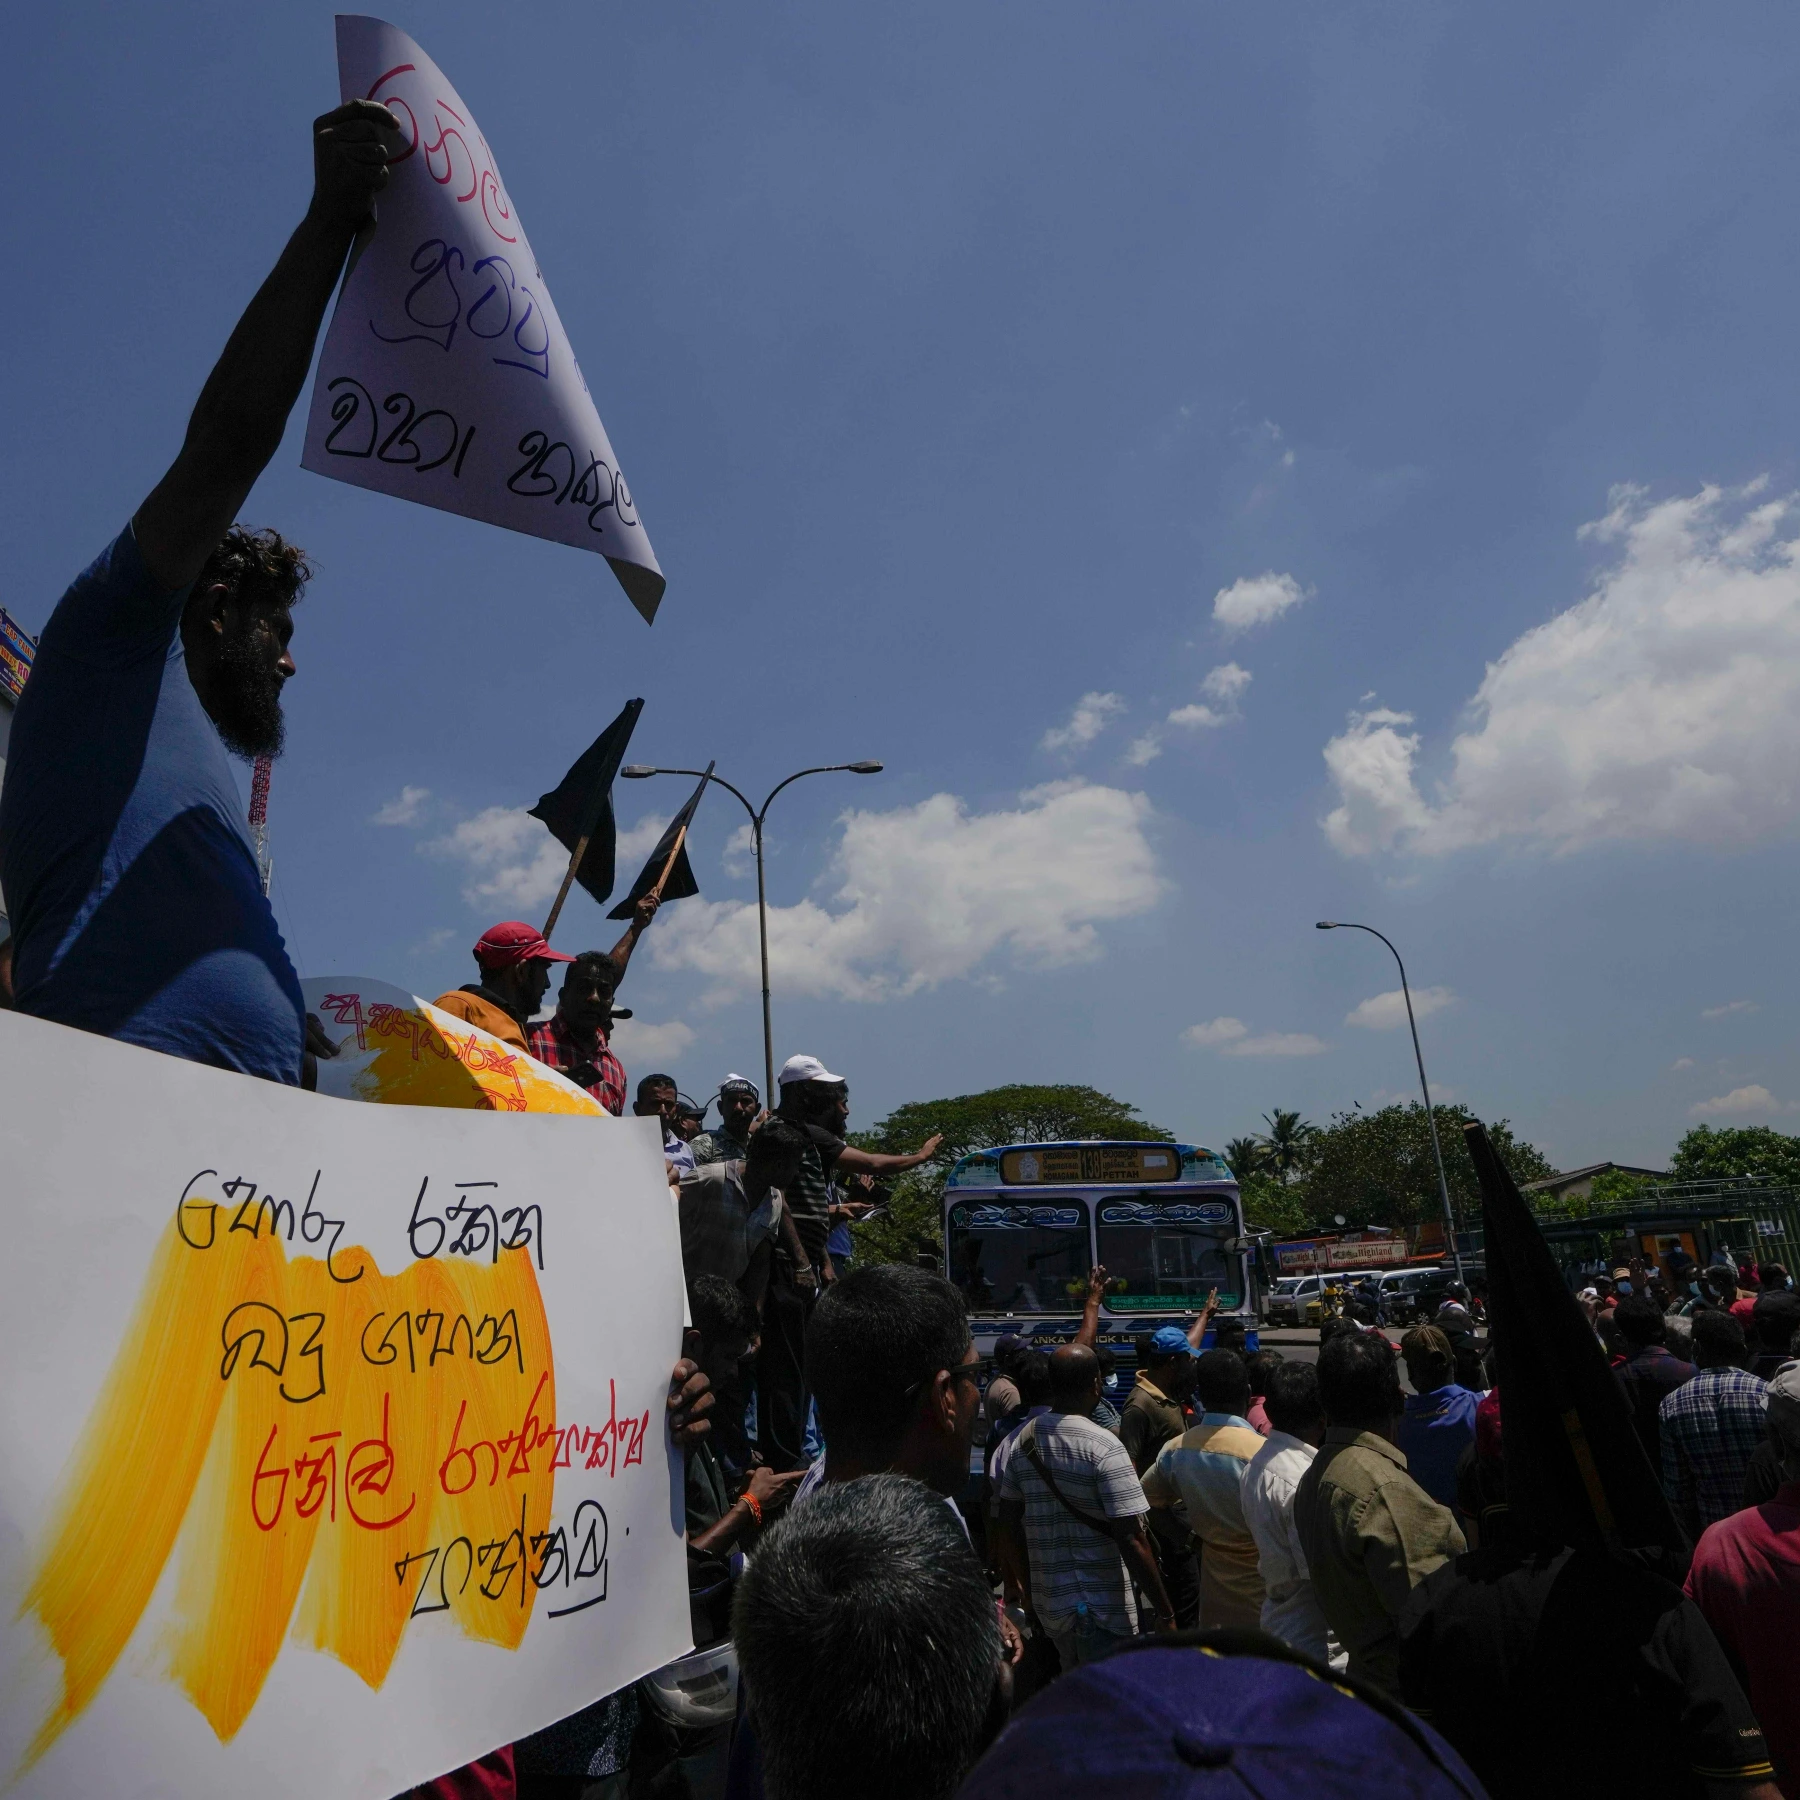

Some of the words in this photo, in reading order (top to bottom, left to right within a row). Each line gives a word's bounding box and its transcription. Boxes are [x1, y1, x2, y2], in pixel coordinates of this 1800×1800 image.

[325, 376, 476, 479] වහා
[506, 429, 641, 533] හකුල
[1081, 1149, 1101, 1179] 138
[1043, 1171, 1079, 1180] HOMAGAMA
[1103, 1170, 1140, 1179] PETTAH
[1357, 1246, 1393, 1258] Highland
[1034, 1336, 1066, 1344] ANKA
[1121, 1335, 1141, 1344] LE
